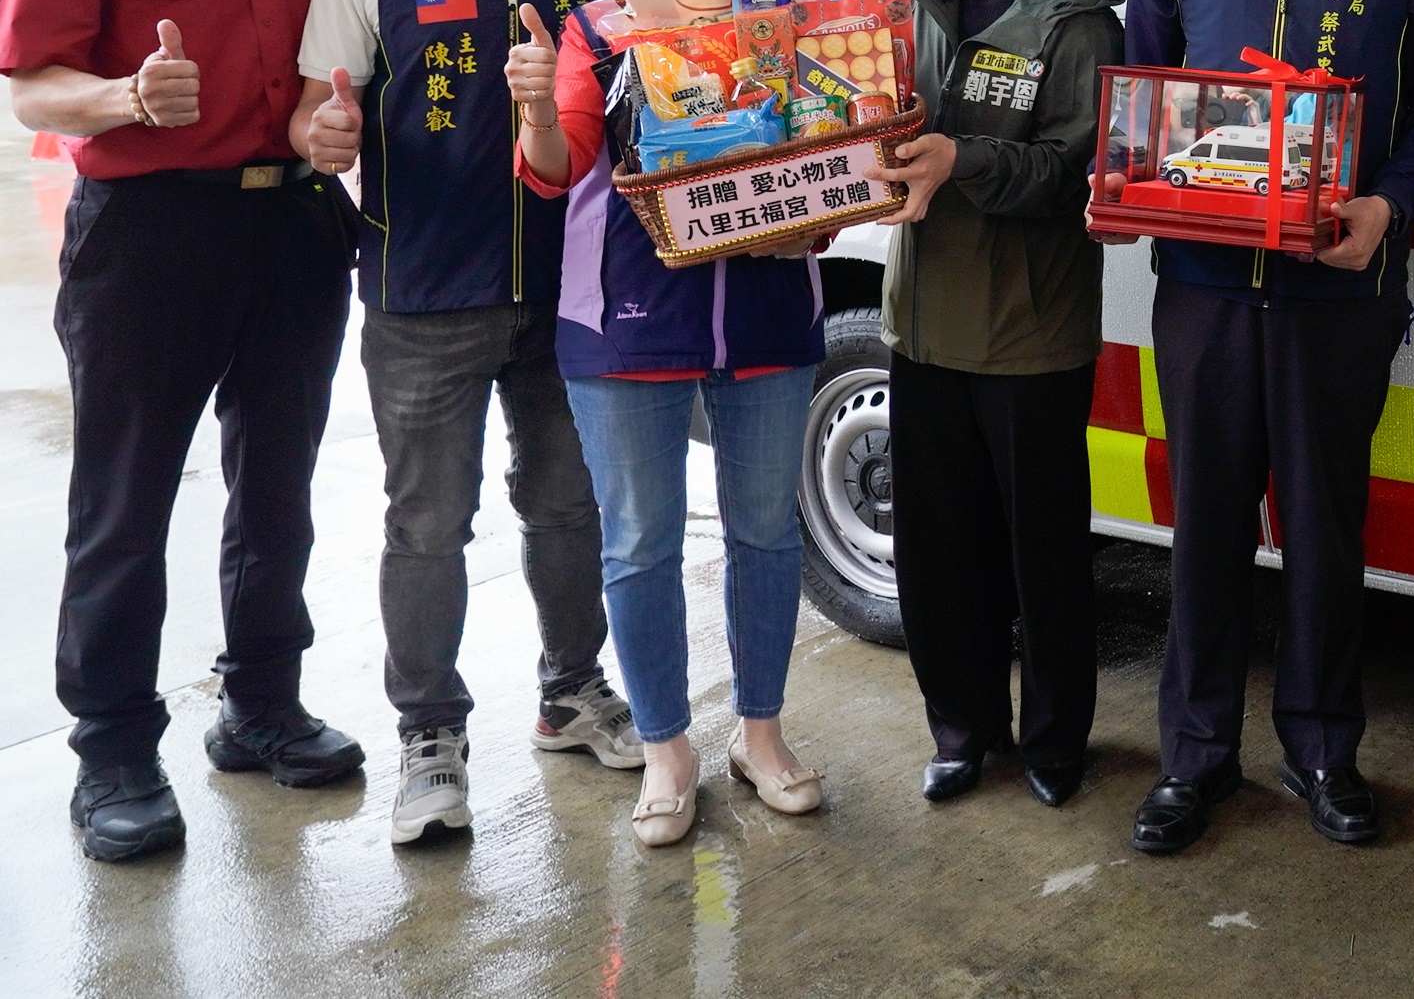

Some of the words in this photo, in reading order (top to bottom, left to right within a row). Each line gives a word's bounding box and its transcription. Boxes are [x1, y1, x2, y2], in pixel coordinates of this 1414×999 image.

[456, 32, 477, 75] 主任
[974, 52, 1027, 73] 新北市議員
[425, 42, 457, 132] 陳敬叡
[963, 69, 1039, 112] 鄭宇恩
[686, 180, 739, 210] 捐贈
[750, 155, 852, 197] 愛心物資
[686, 196, 809, 241] 八里五福宮
[820, 180, 871, 210] 敬贈
